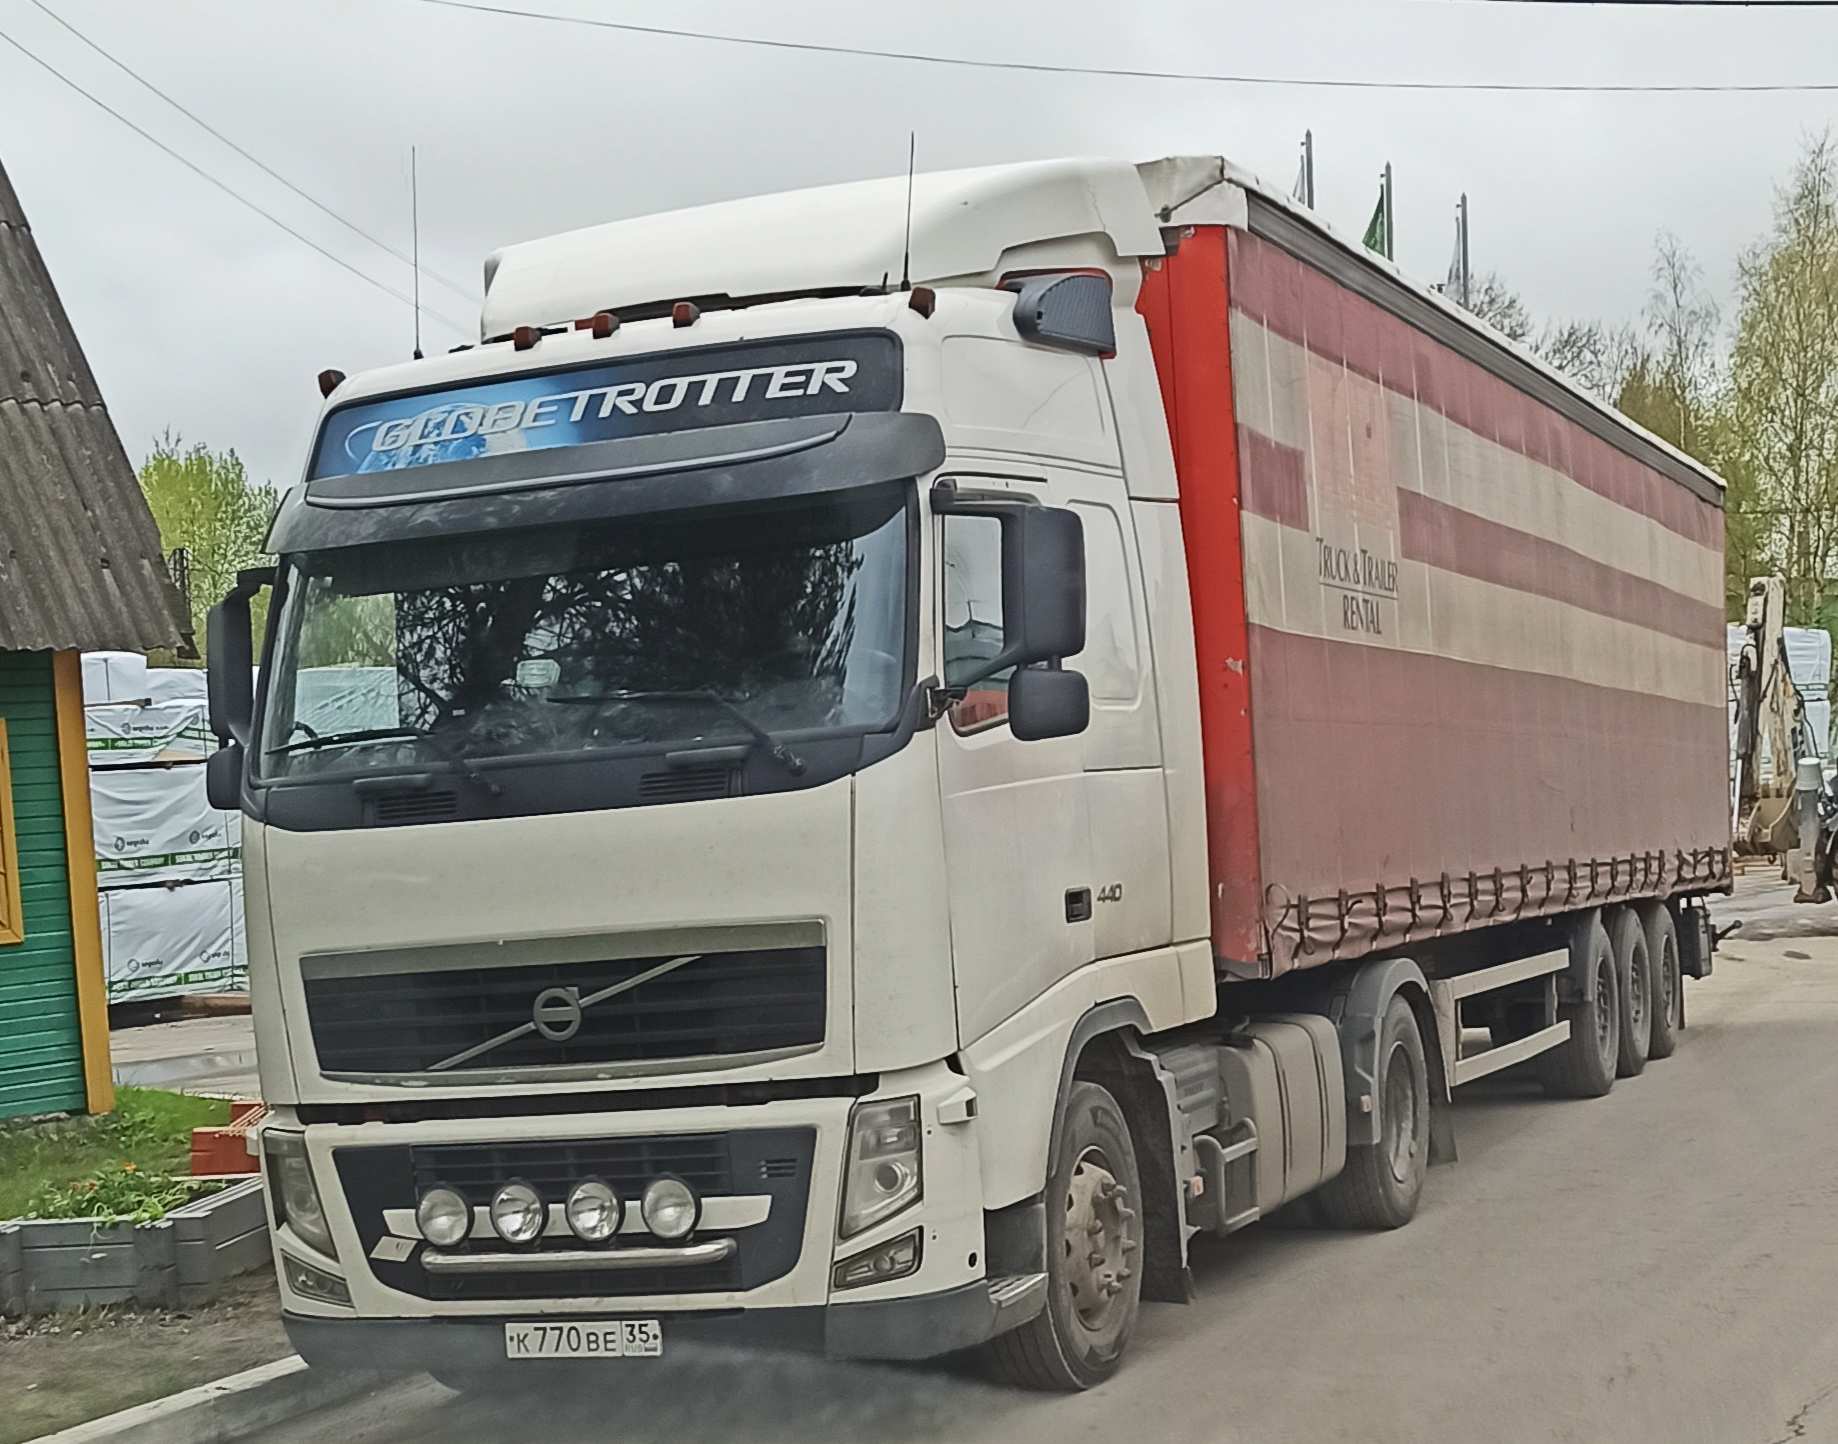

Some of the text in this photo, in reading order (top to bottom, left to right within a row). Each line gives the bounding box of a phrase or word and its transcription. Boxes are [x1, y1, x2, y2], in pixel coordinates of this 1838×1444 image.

[371, 360, 858, 452] GLOBETROTTER
[1316, 537, 1399, 593] TRUCK & TRAILER
[1343, 595, 1382, 634] RENTAL
[1097, 883, 1122, 903] 440
[624, 1323, 651, 1343] 35
